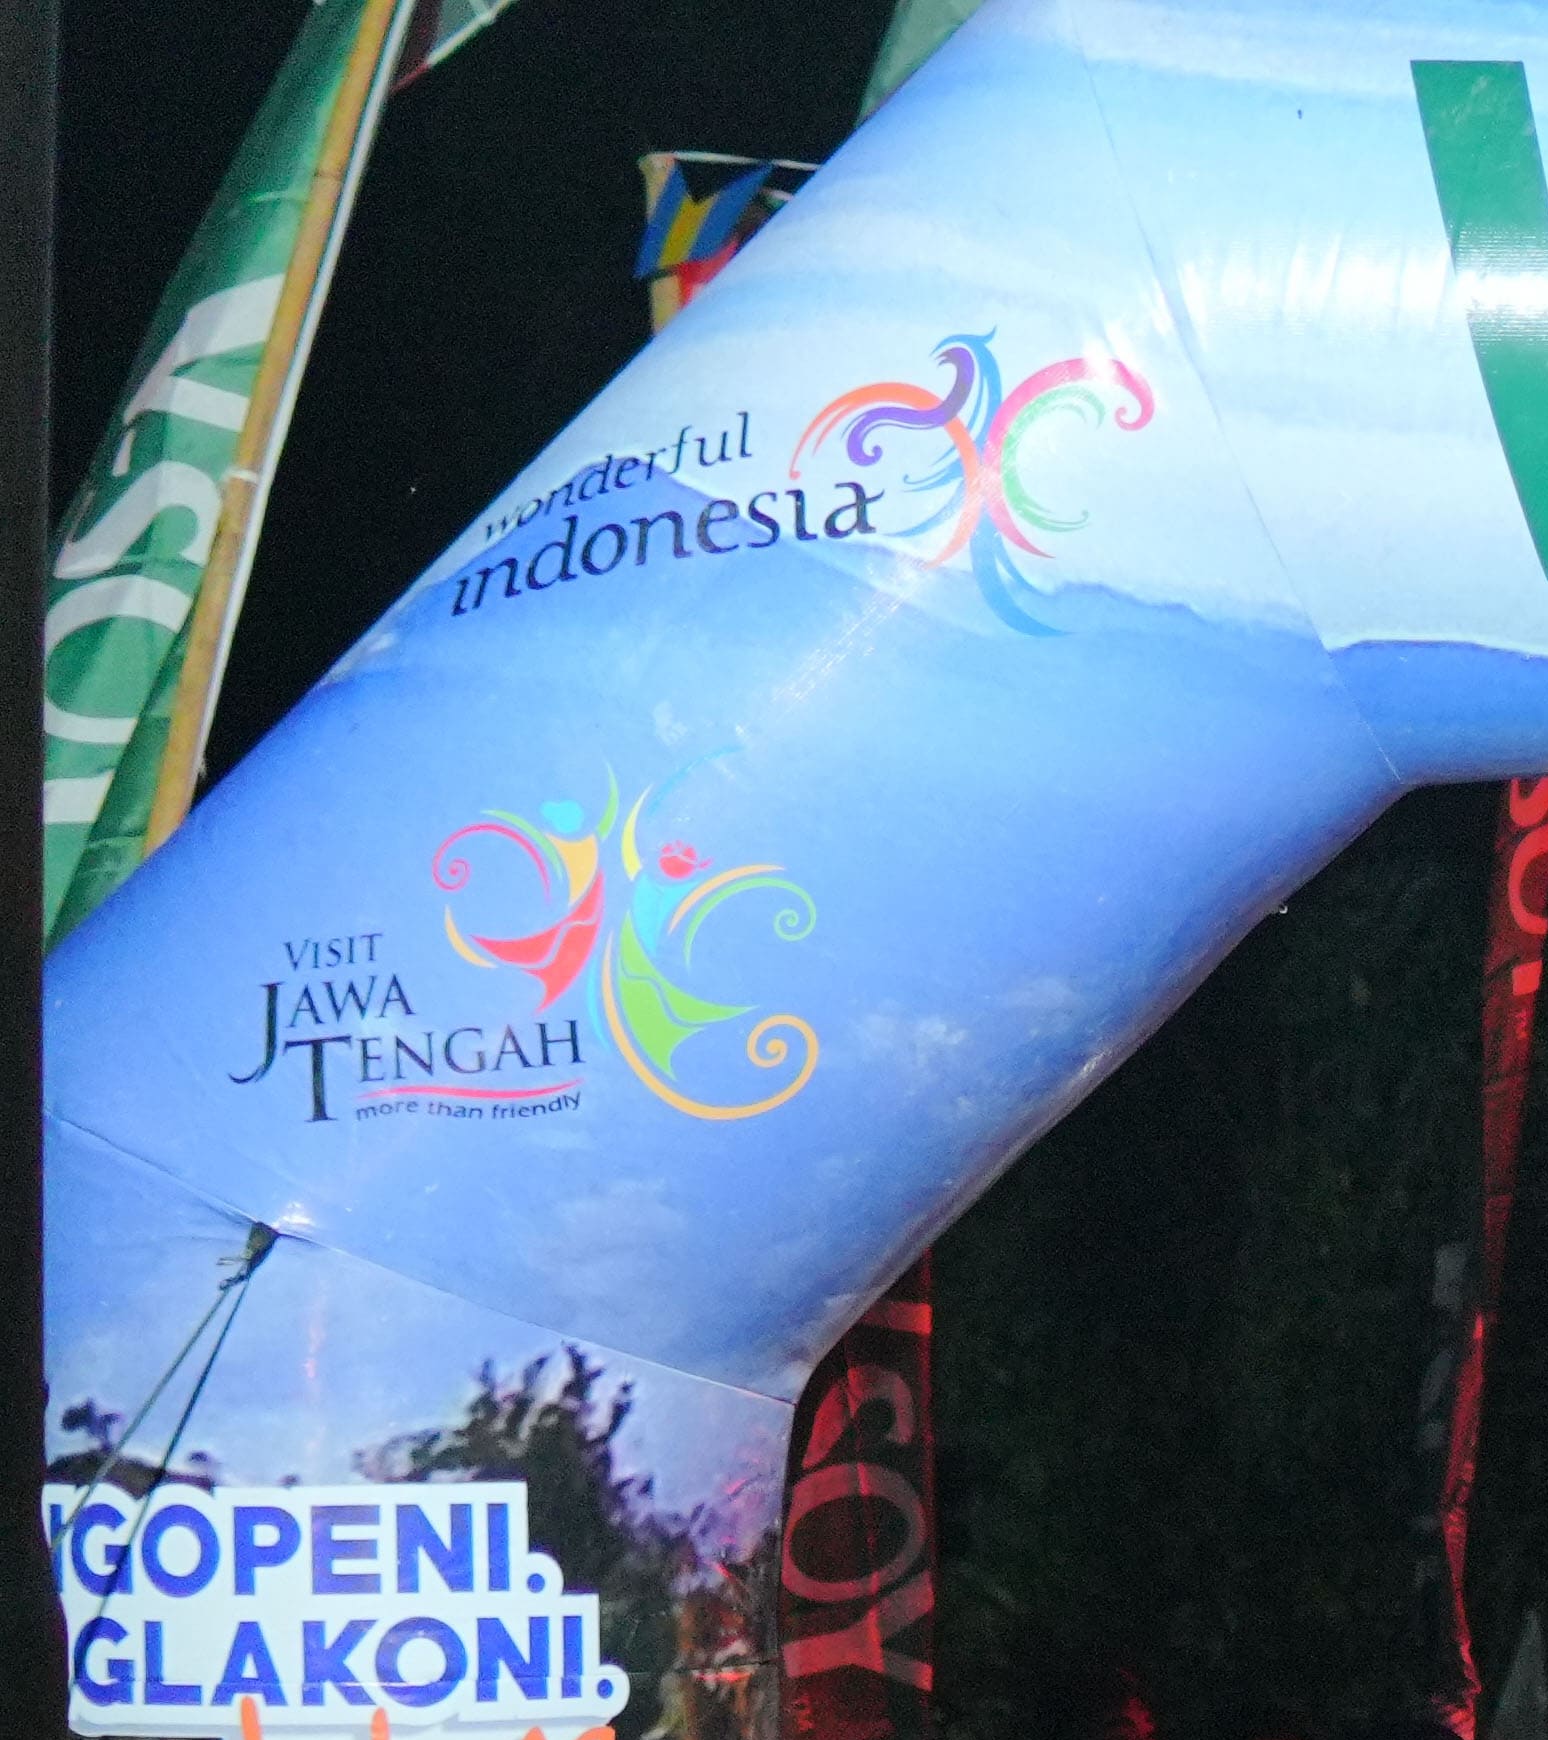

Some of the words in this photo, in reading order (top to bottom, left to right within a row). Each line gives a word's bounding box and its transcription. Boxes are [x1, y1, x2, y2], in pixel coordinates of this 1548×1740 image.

[485, 411, 753, 541] wonderful
[452, 481, 885, 616] indonesia
[284, 933, 383, 971] VISIT
[227, 973, 416, 1085] JAWA
[282, 1019, 587, 1123] TENGAH
[356, 1100, 419, 1122] more
[427, 1101, 484, 1121] than
[490, 1090, 583, 1121] friendly
